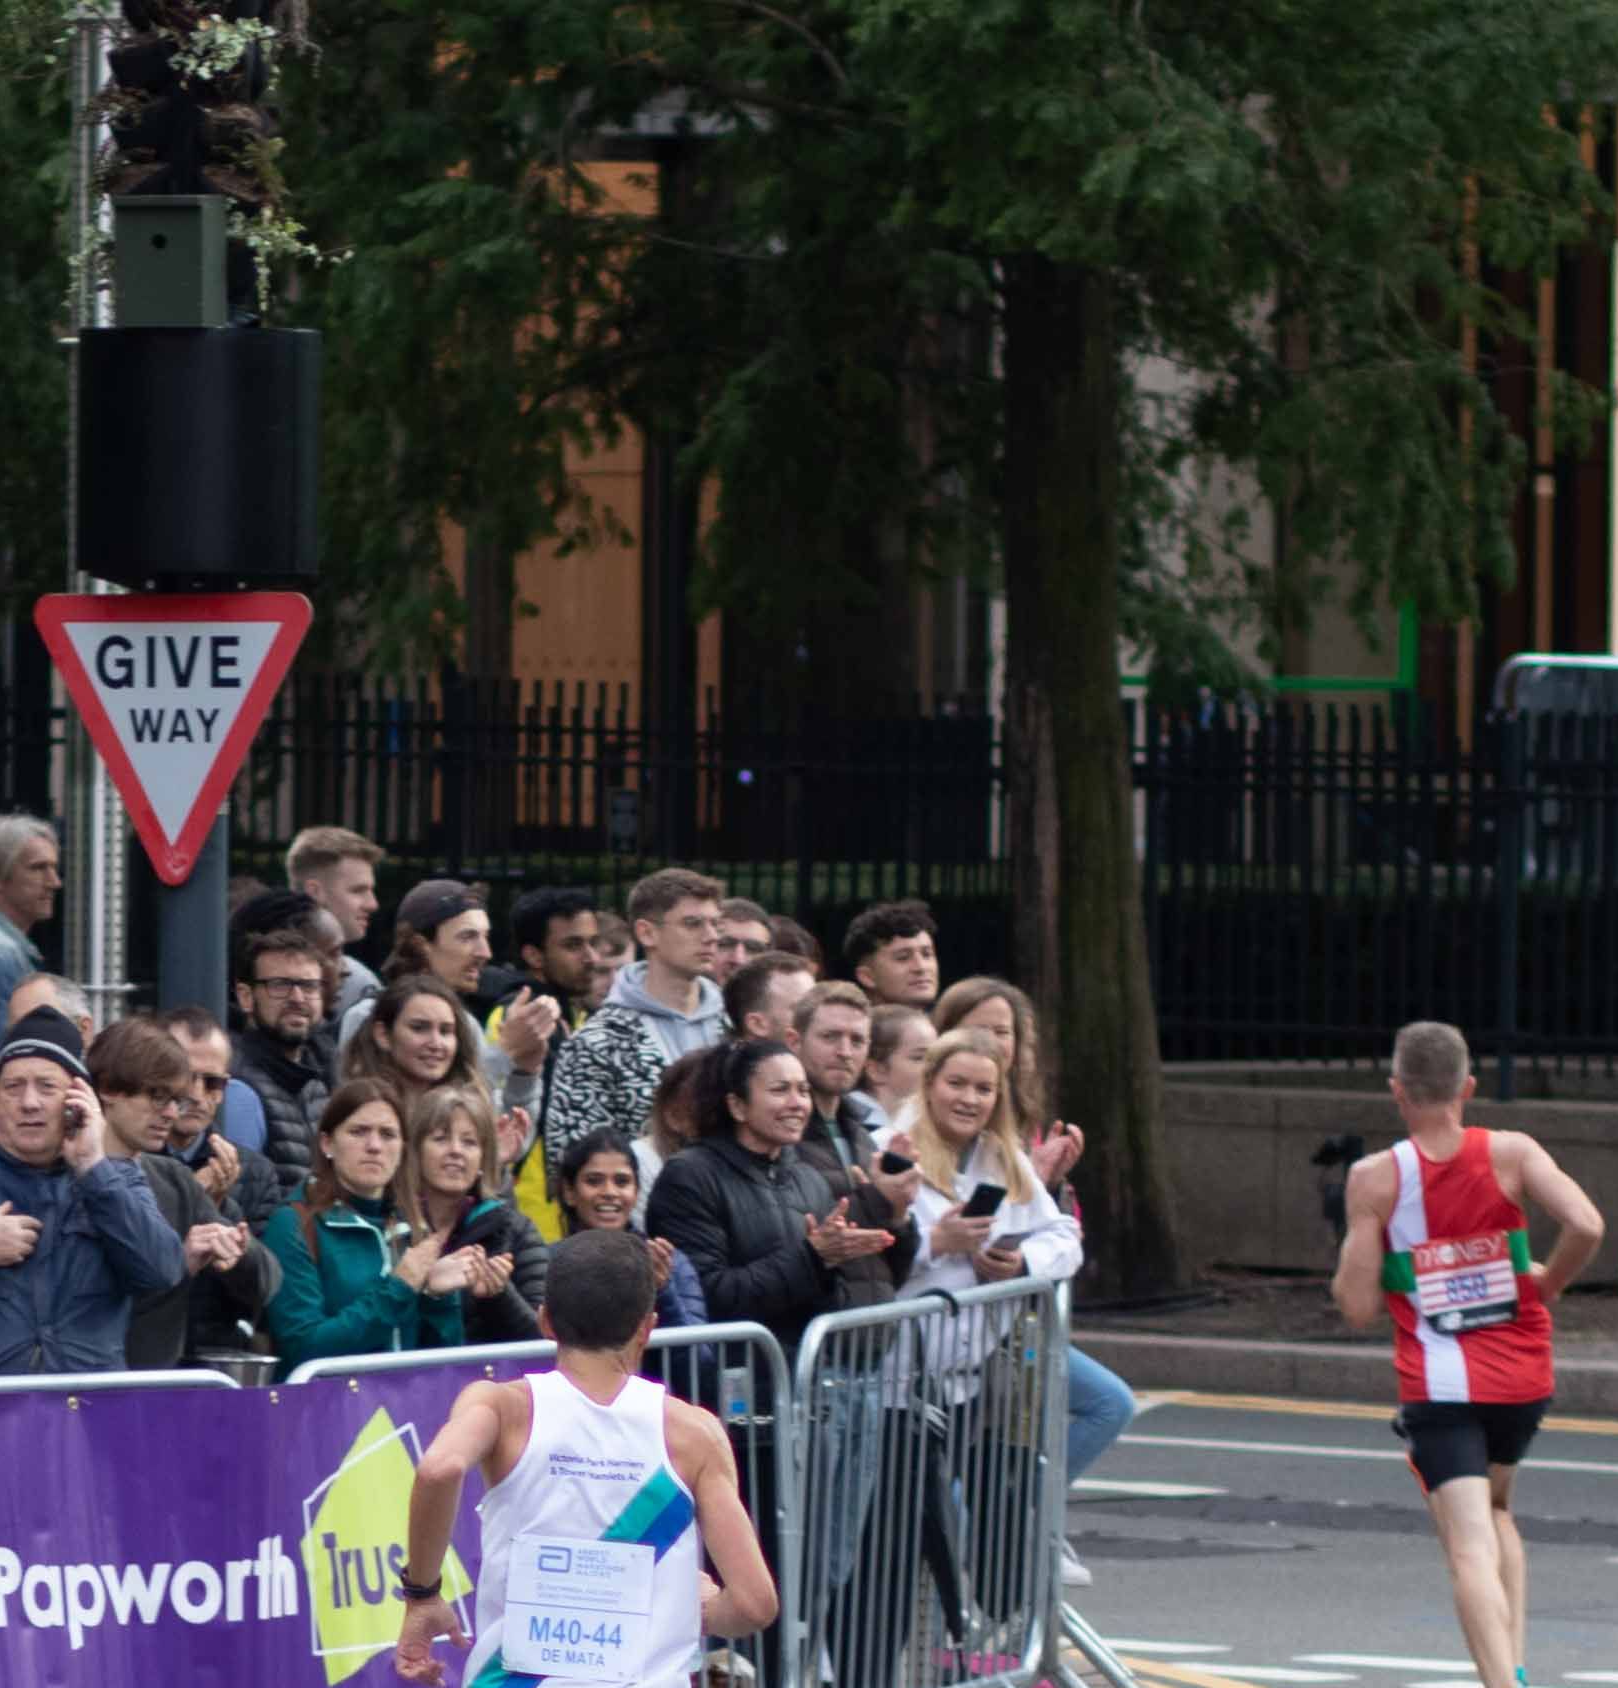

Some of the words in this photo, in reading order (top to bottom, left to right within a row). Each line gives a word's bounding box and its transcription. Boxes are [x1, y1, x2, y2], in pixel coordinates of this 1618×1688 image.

[95, 634, 242, 690] GIVE
[130, 708, 220, 743] WAY
[322, 1532, 405, 1610] Trus
[528, 1615, 622, 1649] M40-44
[542, 1647, 561, 1662] DE
[565, 1650, 605, 1667] MATA
